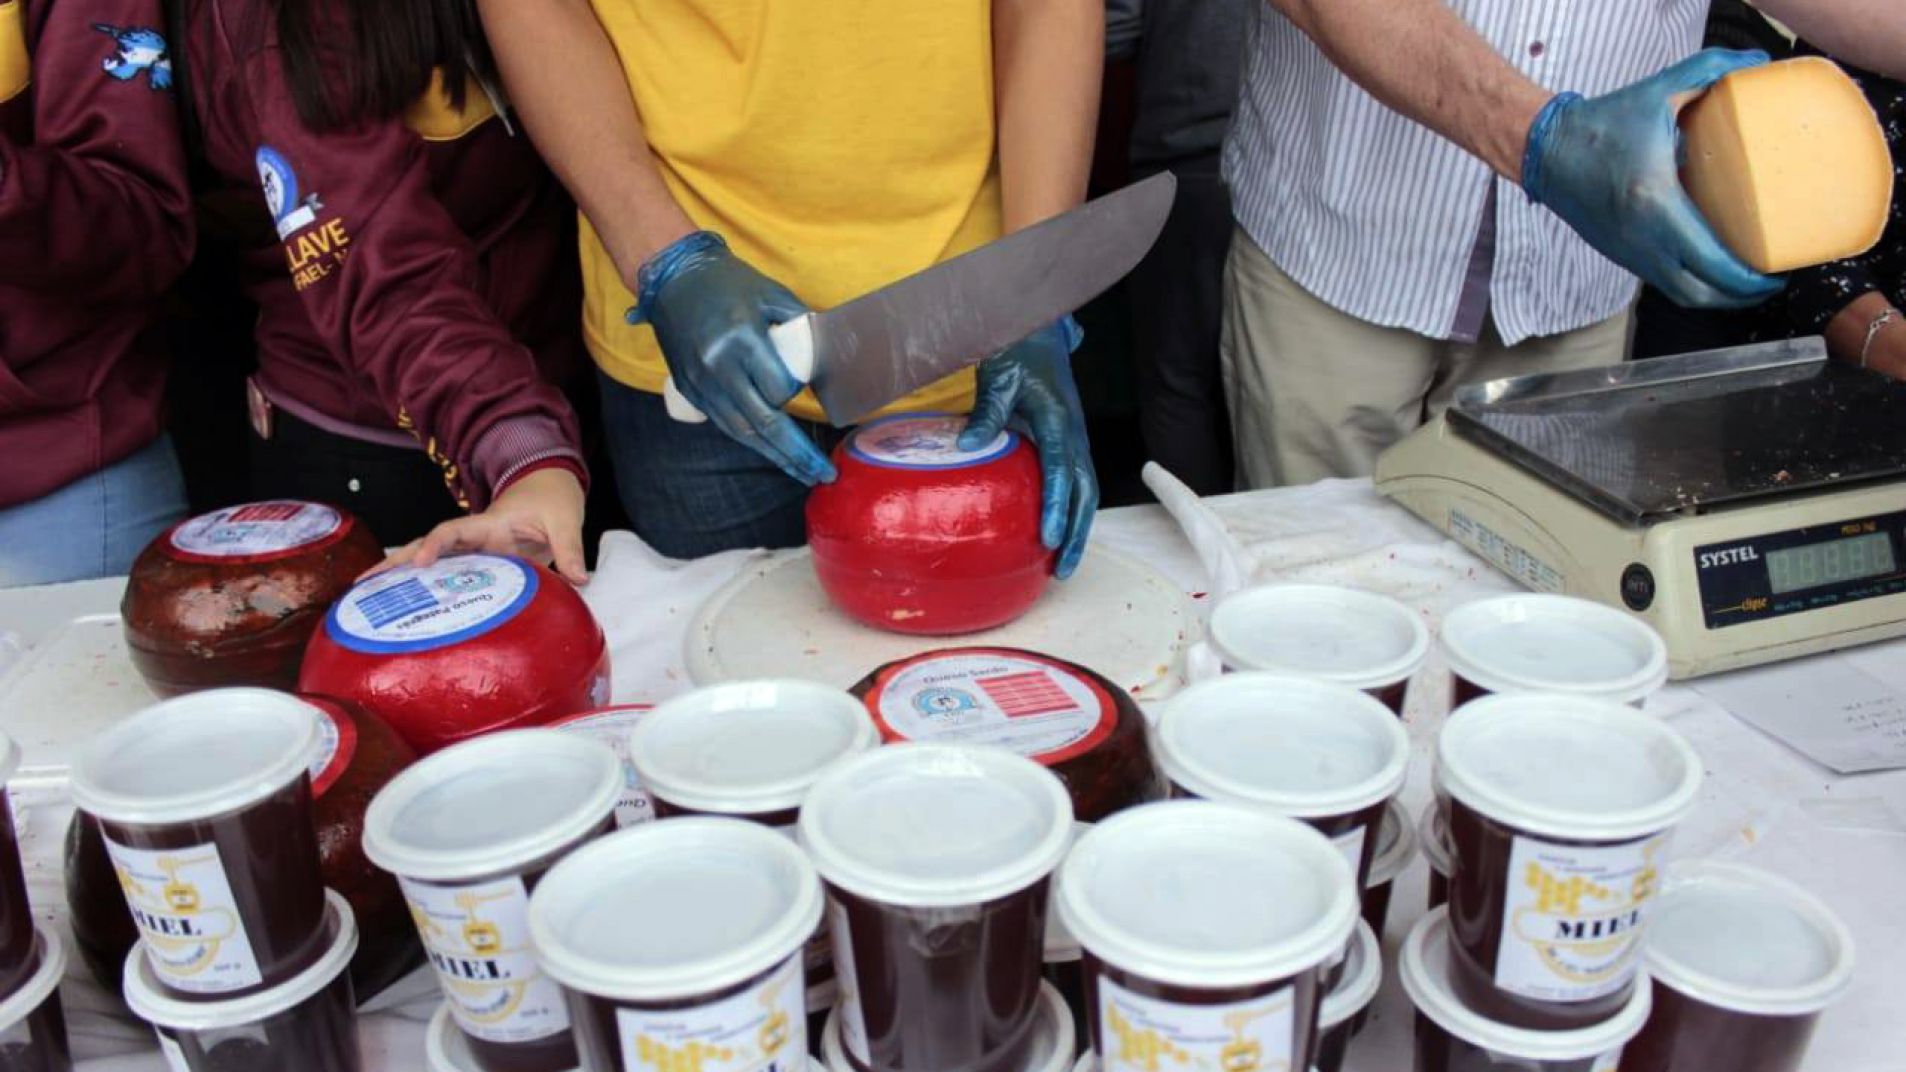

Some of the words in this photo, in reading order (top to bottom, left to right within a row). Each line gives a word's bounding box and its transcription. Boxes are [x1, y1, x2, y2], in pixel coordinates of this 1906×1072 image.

[1700, 546, 1760, 568] SYSTEL
[1555, 910, 1641, 939] MIEL
[431, 951, 512, 980] MIEL
